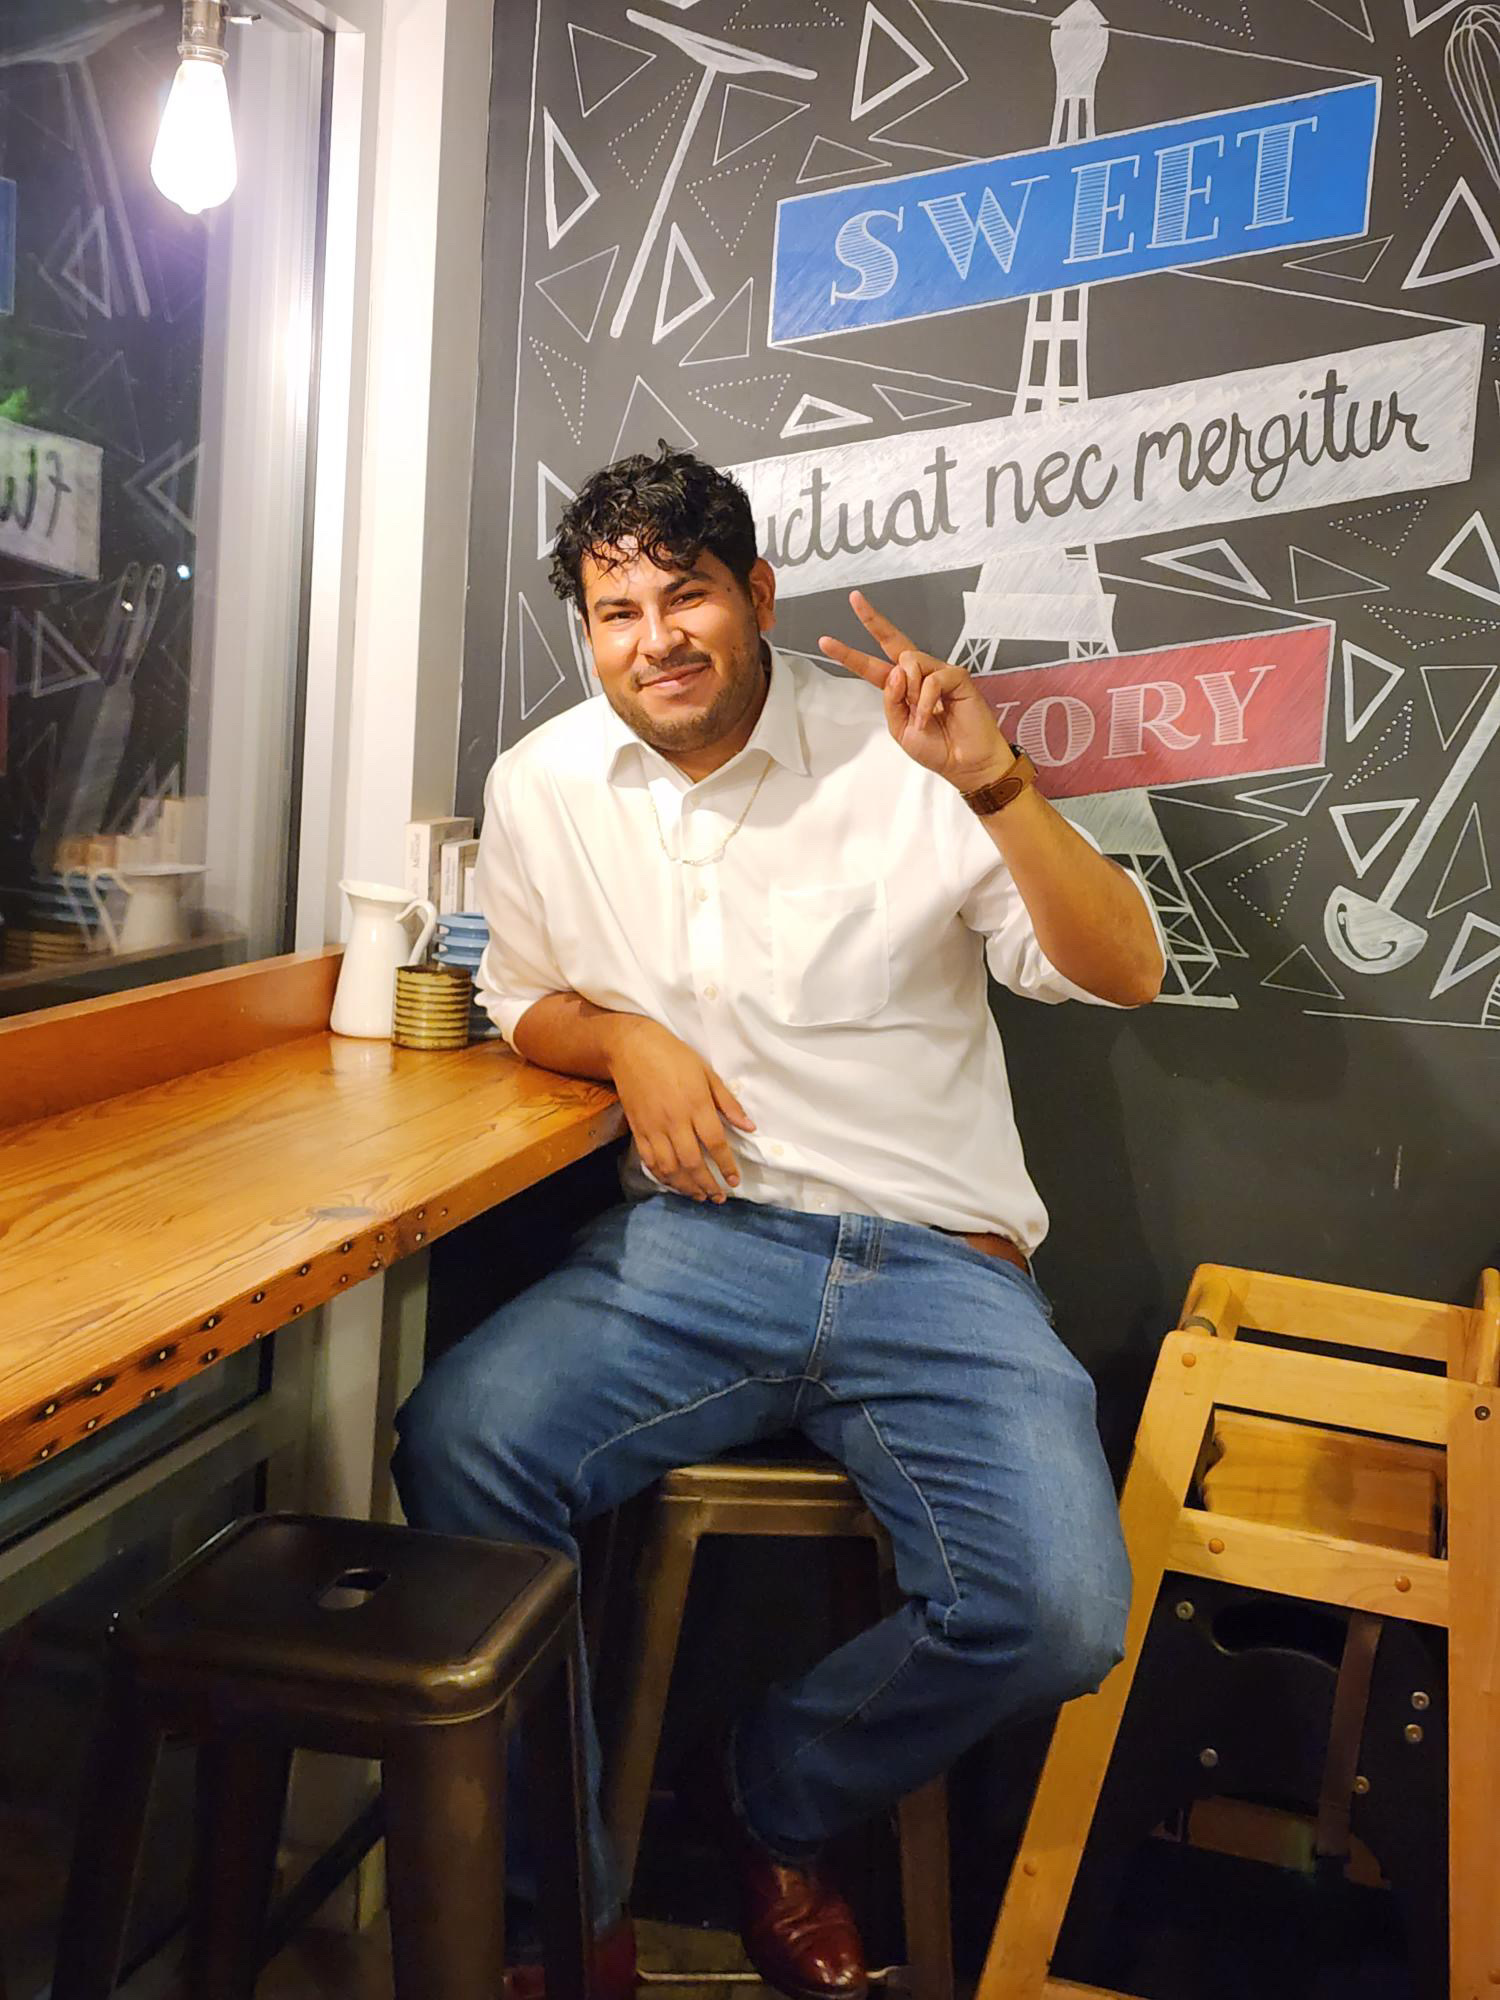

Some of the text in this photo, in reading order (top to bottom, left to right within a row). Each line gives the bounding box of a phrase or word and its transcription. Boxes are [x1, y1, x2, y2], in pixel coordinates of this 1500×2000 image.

[831, 116, 1318, 305] SWEET
[986, 443, 1118, 528] nec
[1133, 369, 1430, 502] mergitur
